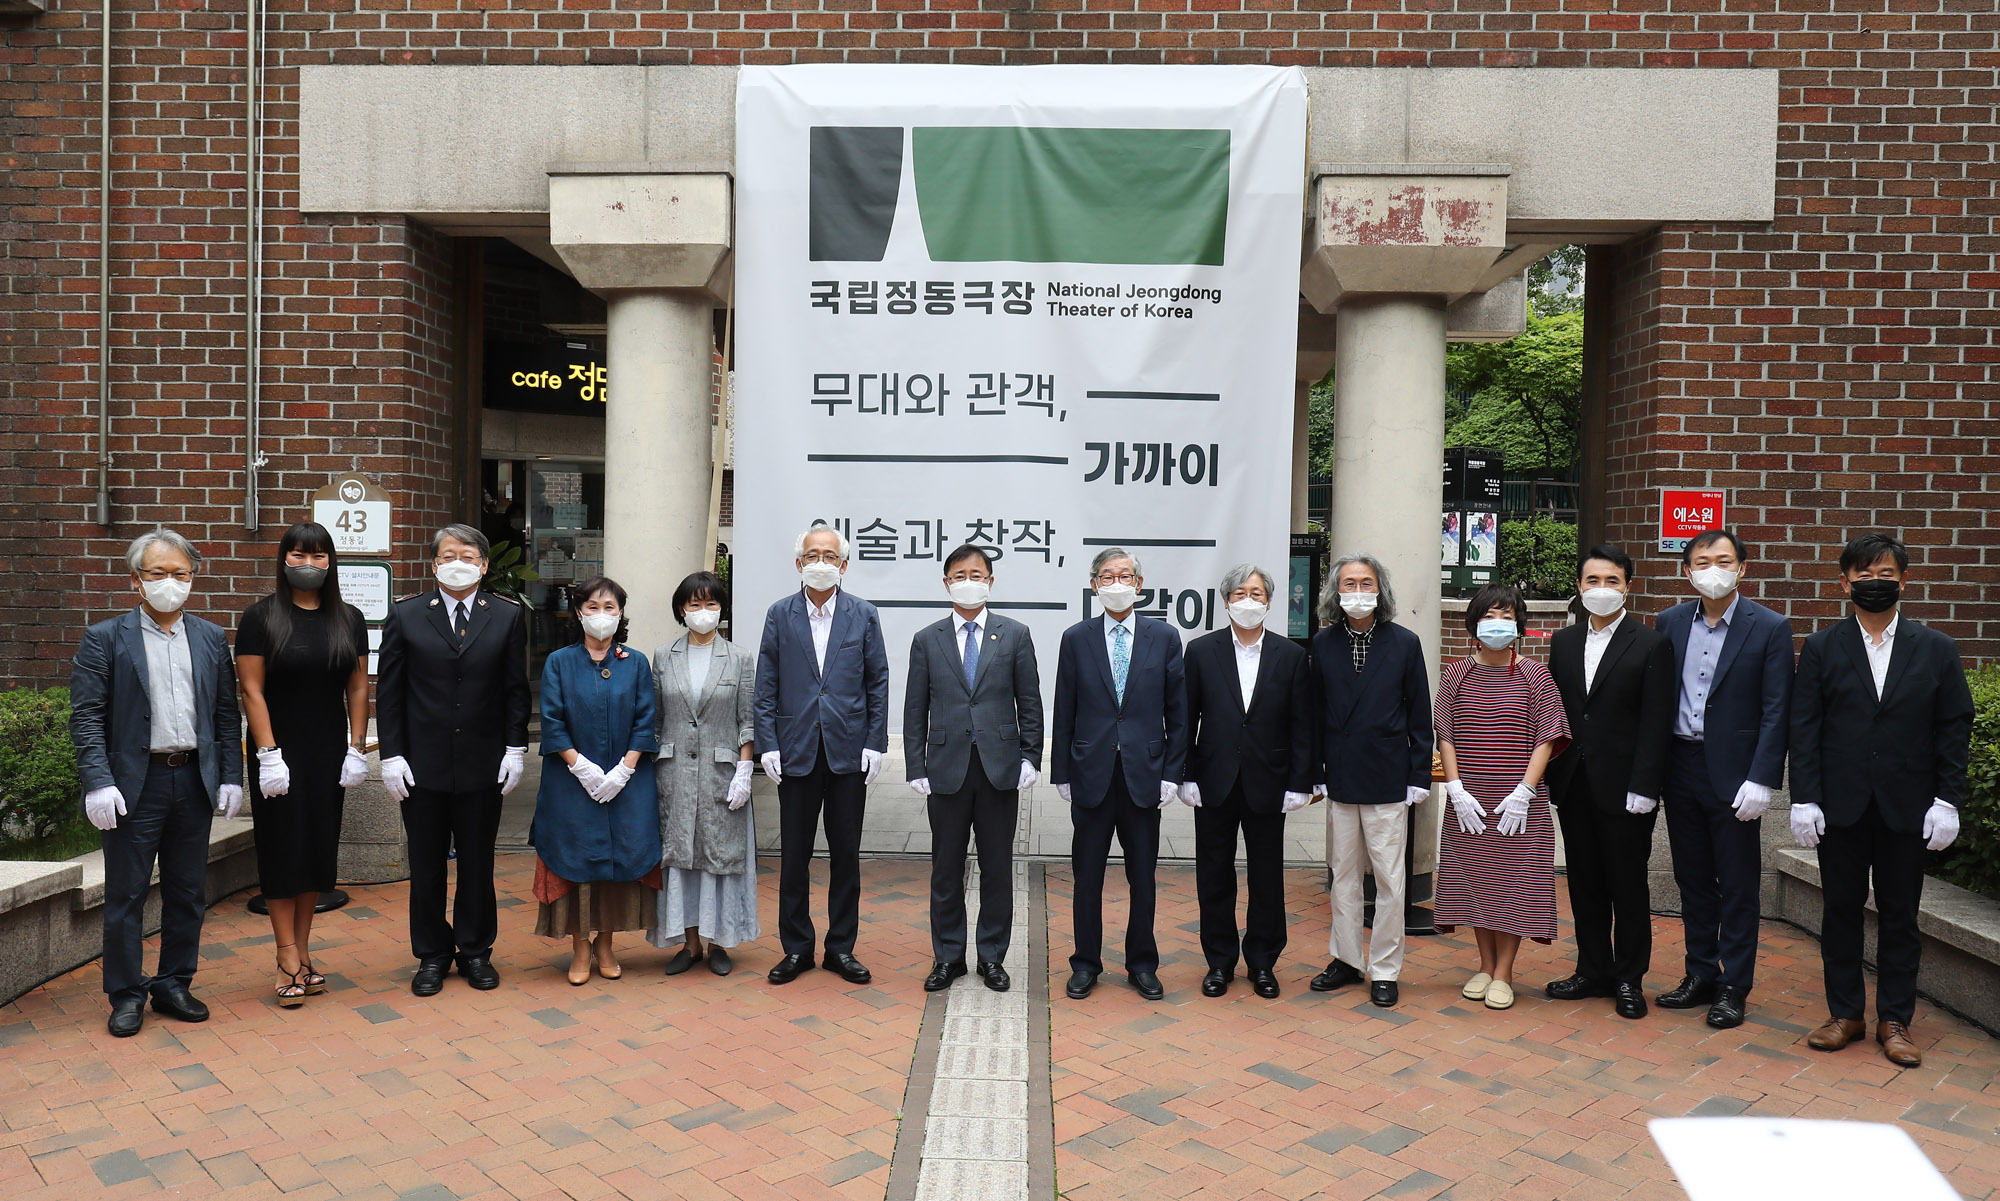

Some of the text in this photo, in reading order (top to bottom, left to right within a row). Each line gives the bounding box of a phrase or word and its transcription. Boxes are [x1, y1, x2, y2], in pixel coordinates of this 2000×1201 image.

[811, 280, 1035, 315] 국립정동극장
[1047, 281, 1222, 303] National Jeongdong
[1046, 301, 1194, 319] Theater of Korea
[511, 370, 562, 390] cafe
[810, 372, 1067, 422] 무대와 관객,
[1084, 441, 1219, 487] 가까이
[335, 510, 367, 533] 43
[1673, 507, 1713, 523] 에스원
[339, 535, 364, 545] 정동길
[964, 518, 1065, 567] 창작,
[1662, 540, 1689, 550] SECO
